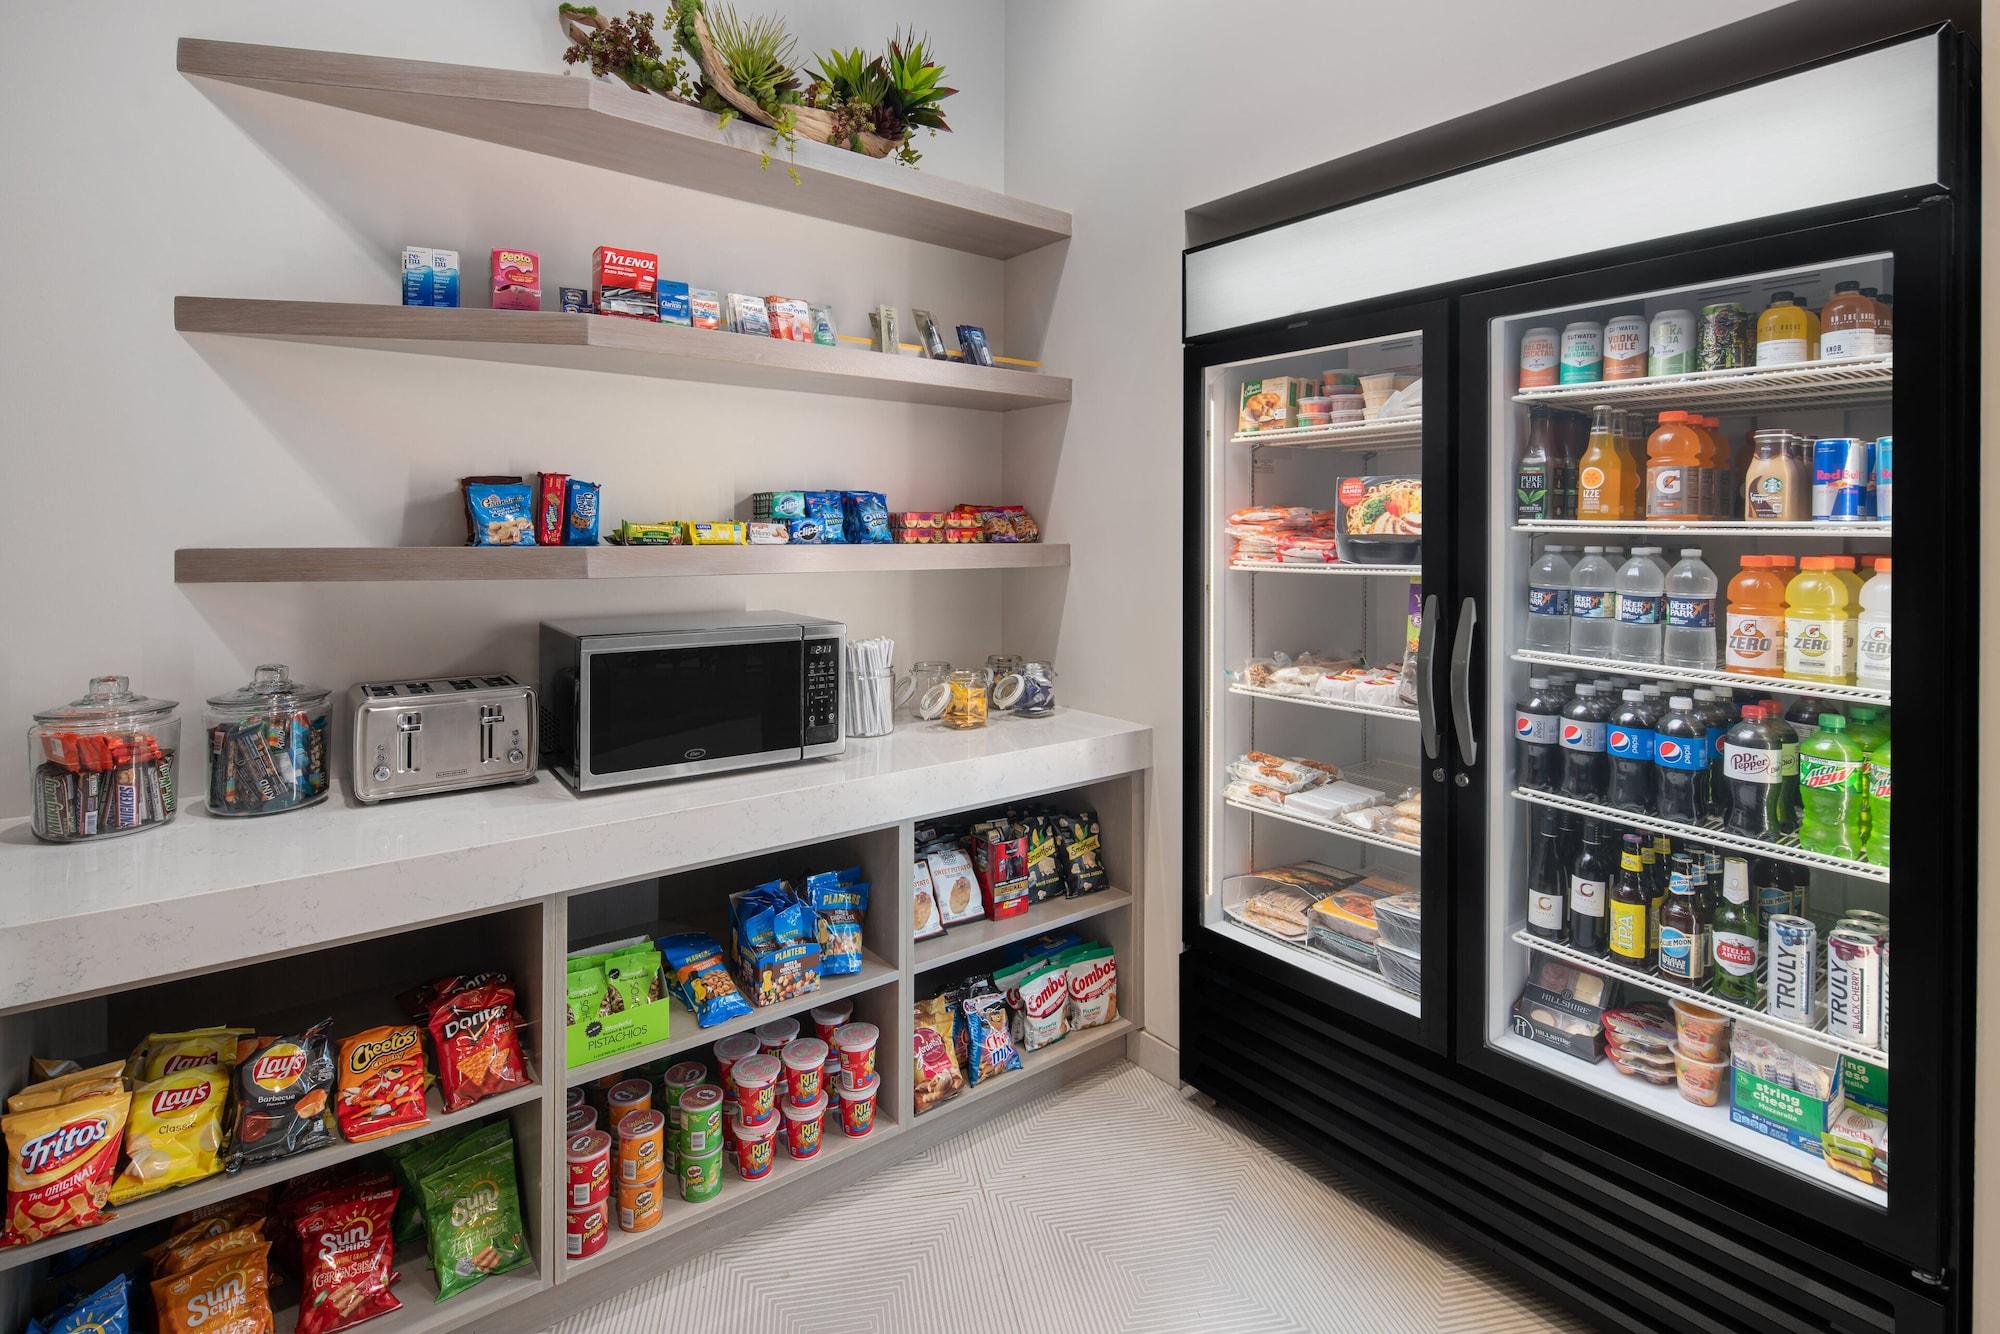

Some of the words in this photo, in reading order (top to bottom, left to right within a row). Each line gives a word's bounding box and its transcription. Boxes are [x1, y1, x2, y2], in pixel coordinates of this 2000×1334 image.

[502, 252, 531, 263] Pepto
[604, 251, 655, 269] TYLENOL
[662, 300, 681, 309] Claritin
[1523, 343, 1554, 351] PALOMA
[1609, 334, 1639, 345] VODKA
[1610, 344, 1636, 353] MULE
[1521, 475, 1542, 483] PURE
[1817, 470, 1841, 480] Red
[1584, 490, 1601, 499] IZZE
[864, 513, 887, 521] OREO
[794, 524, 823, 539] eclipse
[1530, 592, 1544, 600] EER
[1623, 600, 1643, 609] DEER
[1623, 606, 1643, 614] PARK
[1670, 602, 1693, 611] DEER
[1670, 610, 1694, 618] PARK
[1730, 638, 1772, 652] ZERO
[278, 730, 286, 750] KIND
[1731, 754, 1769, 772] Pepper
[1744, 753, 1759, 764] Dr
[260, 779, 276, 800] KIND
[120, 786, 134, 829] SNICKERS
[951, 864, 971, 872] POTATO
[824, 894, 861, 906] PLANTERS
[1618, 916, 1634, 950] IPA
[775, 946, 807, 962] PLANTERS
[1722, 945, 1751, 956] STELLA
[1722, 952, 1751, 962] ARTOIS
[1662, 961, 1686, 971] WHITE
[1072, 958, 1116, 995] Combos
[1777, 946, 1797, 1009] TRULY
[1850, 968, 1861, 1000] CHERRY
[1832, 960, 1848, 1025] TRULY
[1542, 993, 1590, 1015] HILLSHIRE
[446, 1005, 508, 1038] Doritos
[1850, 1001, 1860, 1029] BLACK
[588, 1025, 648, 1050] PISTACHIOS
[1534, 1028, 1571, 1046] HILLSHIRE
[352, 1029, 418, 1071] Cheetos
[256, 1051, 306, 1081] Lay's
[800, 1071, 818, 1087] RITZ
[1845, 1071, 1870, 1084] ese
[156, 1082, 210, 1114] Lay's
[258, 1094, 295, 1104] Barbecue
[1756, 1082, 1801, 1107] string
[854, 1101, 872, 1116] RITZ
[1752, 1092, 1804, 1117] cheese
[1758, 1102, 1798, 1122] Mozzarella
[158, 1121, 196, 1134] Classic
[802, 1121, 819, 1137] RITZ
[21, 1119, 108, 1174] Fritos
[752, 1141, 770, 1158] RITZ
[28, 1193, 42, 1201] The
[45, 1165, 96, 1199] ORIGINAL
[452, 1188, 493, 1227] Sun
[320, 1227, 364, 1262] Sun
[338, 1240, 370, 1252] CHIPS
[188, 1279, 240, 1327] Sun
[210, 1294, 246, 1316] CHIPS
